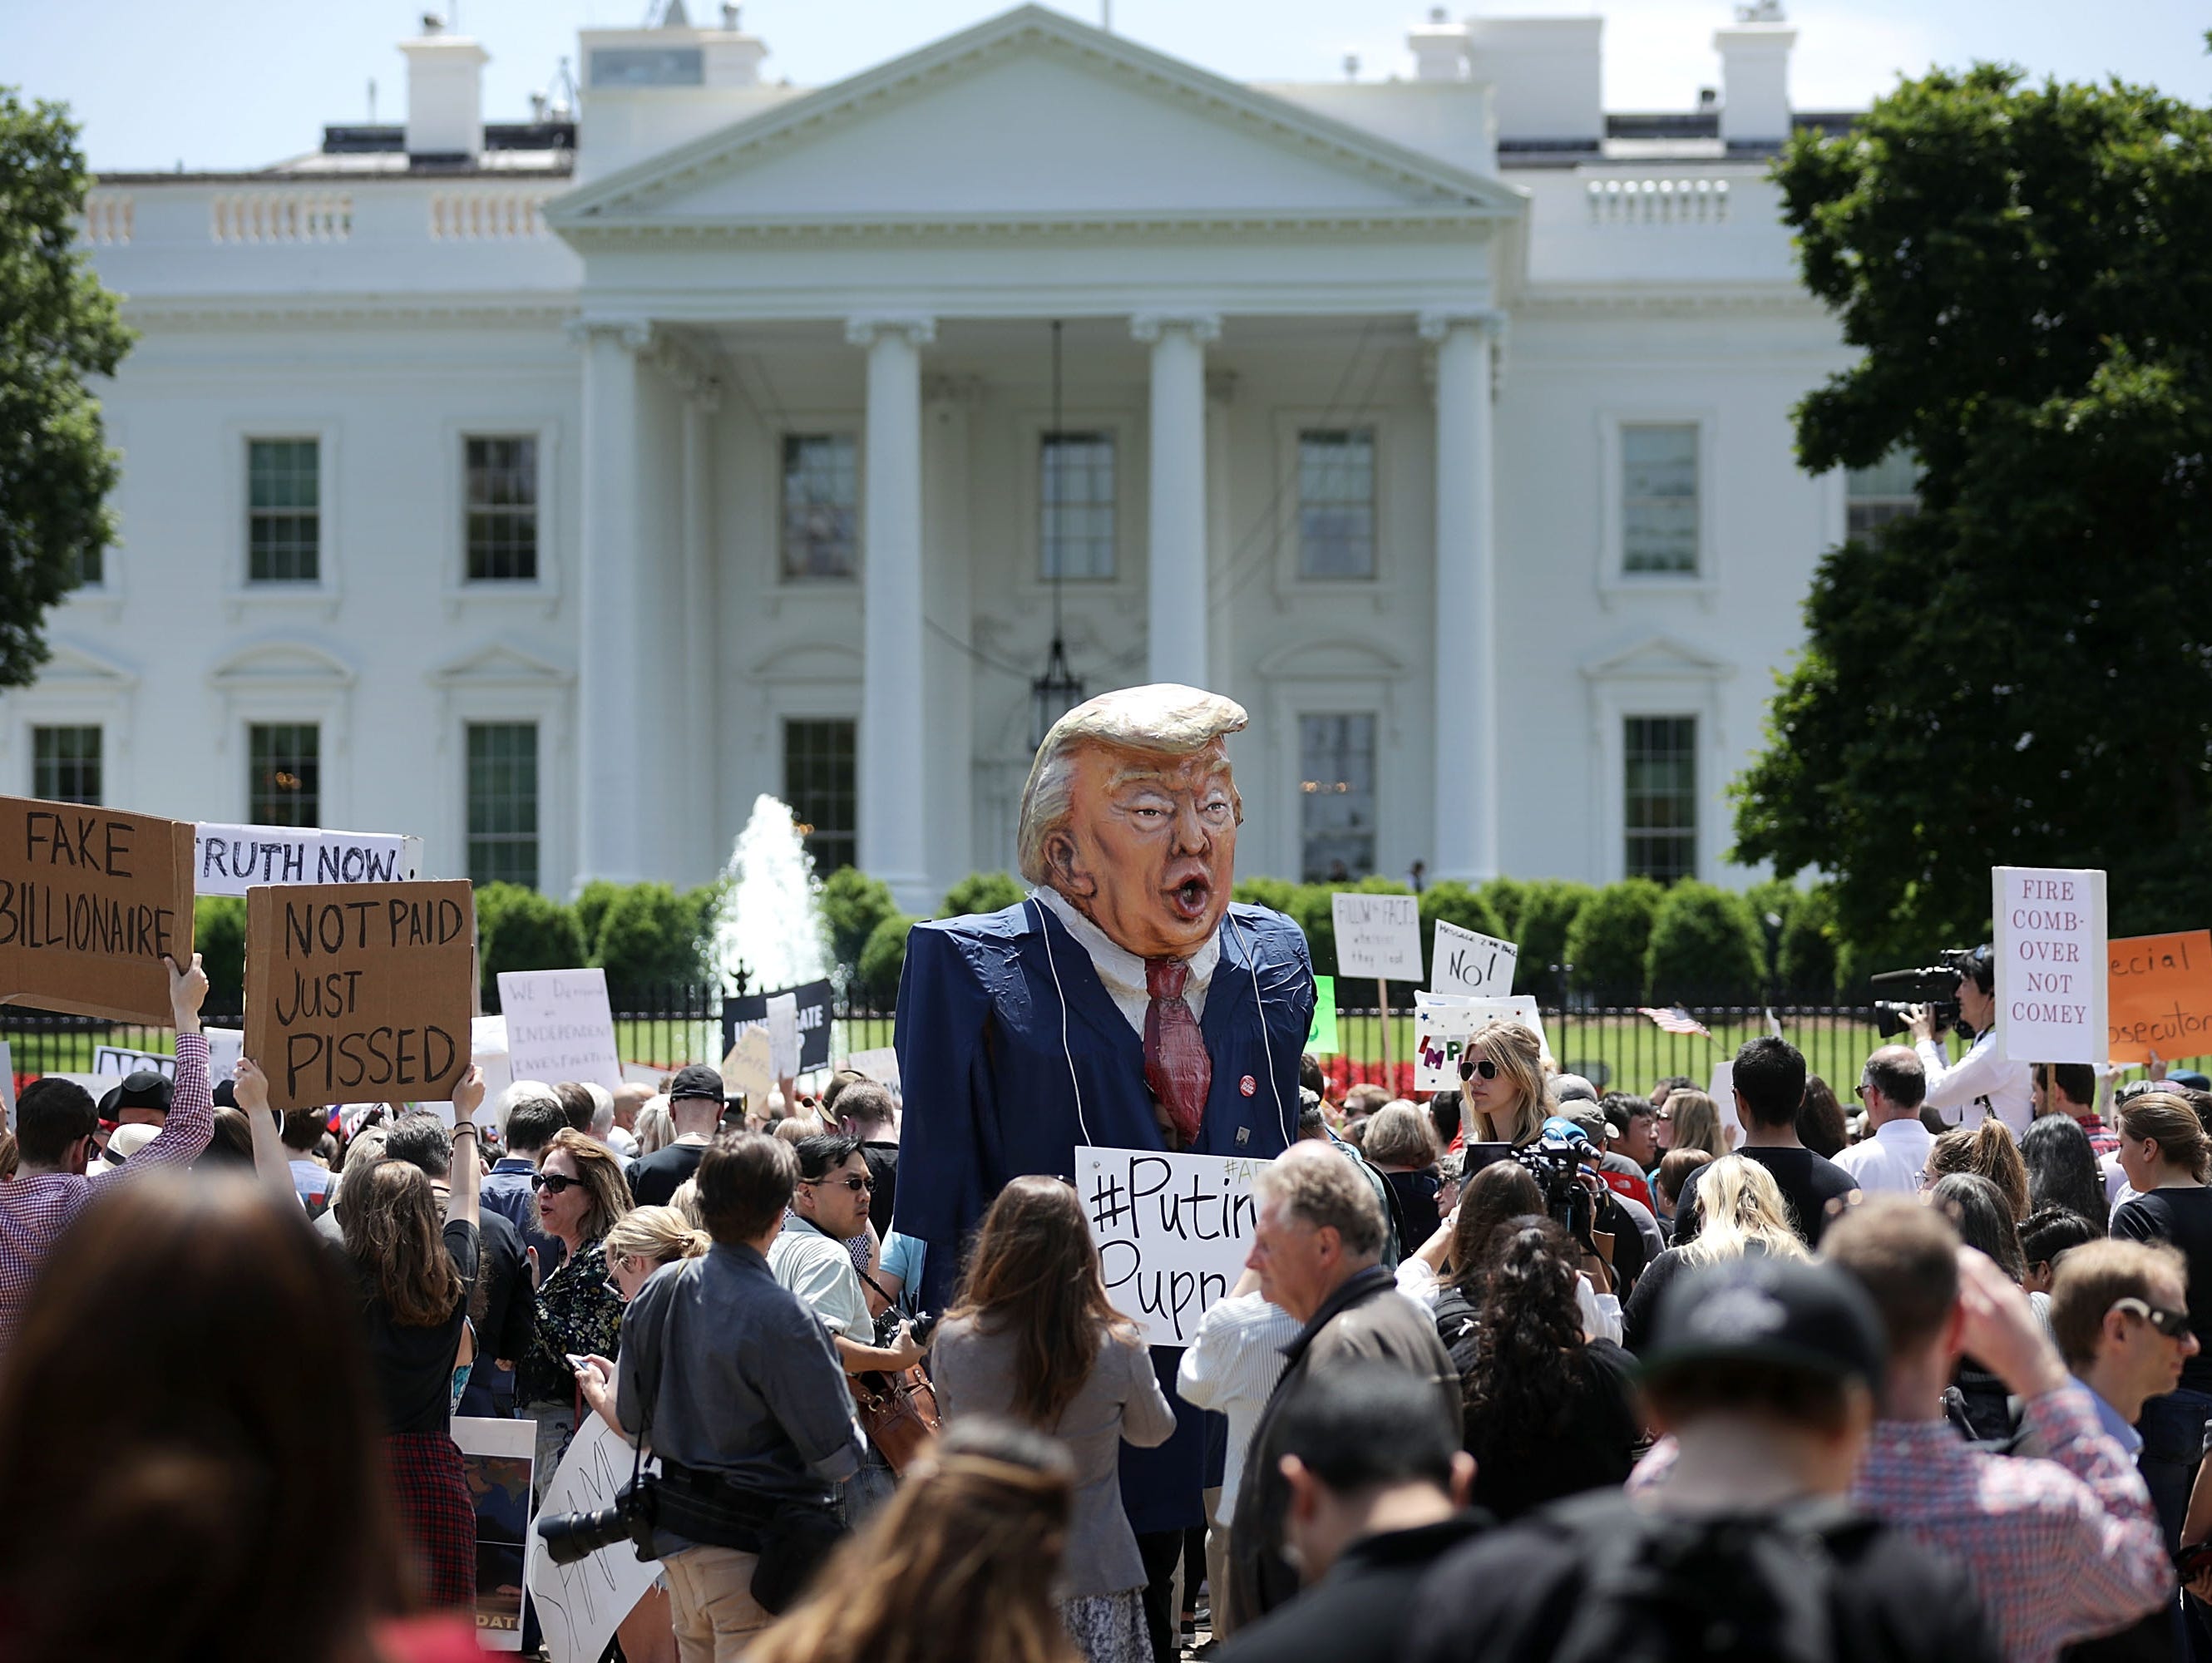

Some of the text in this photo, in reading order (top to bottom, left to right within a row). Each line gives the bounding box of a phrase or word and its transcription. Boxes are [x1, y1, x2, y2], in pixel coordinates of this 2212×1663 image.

[27, 812, 135, 878] FAKE
[196, 836, 304, 881] RUTH
[2022, 879, 2074, 901] FIRE
[0, 880, 174, 959] BILLIONAIRE
[285, 899, 462, 960] NOT PAID
[2012, 910, 2084, 931] COMB-
[1449, 949, 1497, 998] NO!
[2020, 940, 2080, 963] OVER
[275, 967, 363, 1026] JUST
[2027, 972, 2072, 994] NOT
[2012, 1002, 2087, 1024] COMEY
[287, 1025, 456, 1099] PISSED
[476, 1615, 521, 1630] DAT
